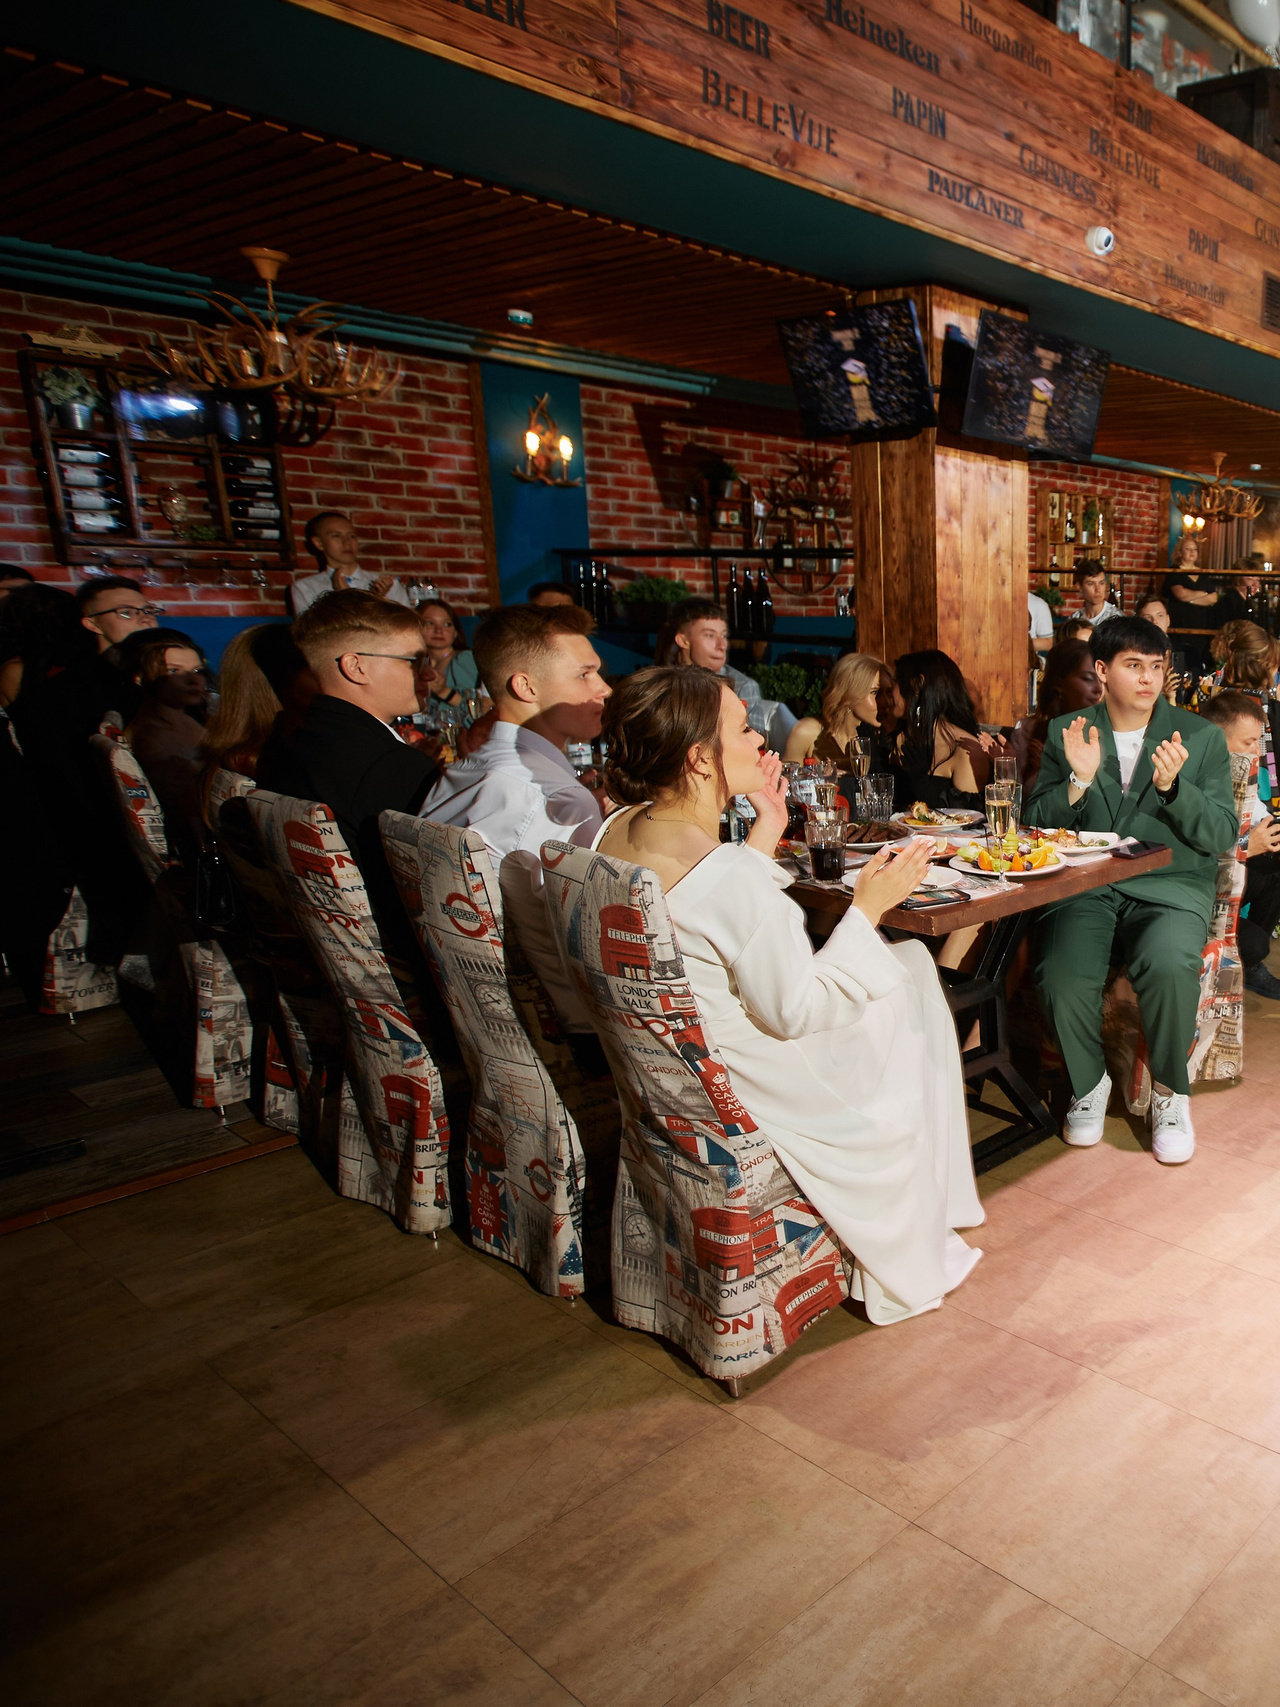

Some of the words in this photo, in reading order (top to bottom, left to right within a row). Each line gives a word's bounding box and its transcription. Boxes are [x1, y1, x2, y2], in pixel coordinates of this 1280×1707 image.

[707, 0, 771, 59] BEER
[825, 0, 940, 75] Heineken
[960, 2, 1052, 76] Hoegaarden
[892, 85, 946, 139] PAPIN
[1127, 99, 1152, 133] BAR
[1019, 143, 1097, 202] GUINNESS
[1197, 141, 1253, 192] Heineken
[928, 168, 1024, 229] PAULANER
[1189, 228, 1218, 262] PAPIN
[1165, 263, 1225, 306] Hoegaarden
[68, 982, 114, 999] TOWER
[620, 996, 654, 1011] WALK
[477, 1207, 496, 1222] CARRY
[482, 1217, 493, 1228] ON
[700, 1228, 749, 1245] TELEPHONE
[669, 1280, 754, 1336] LONDON
[786, 1279, 828, 1315] TELEPHONE
[713, 1348, 759, 1363] PARK
